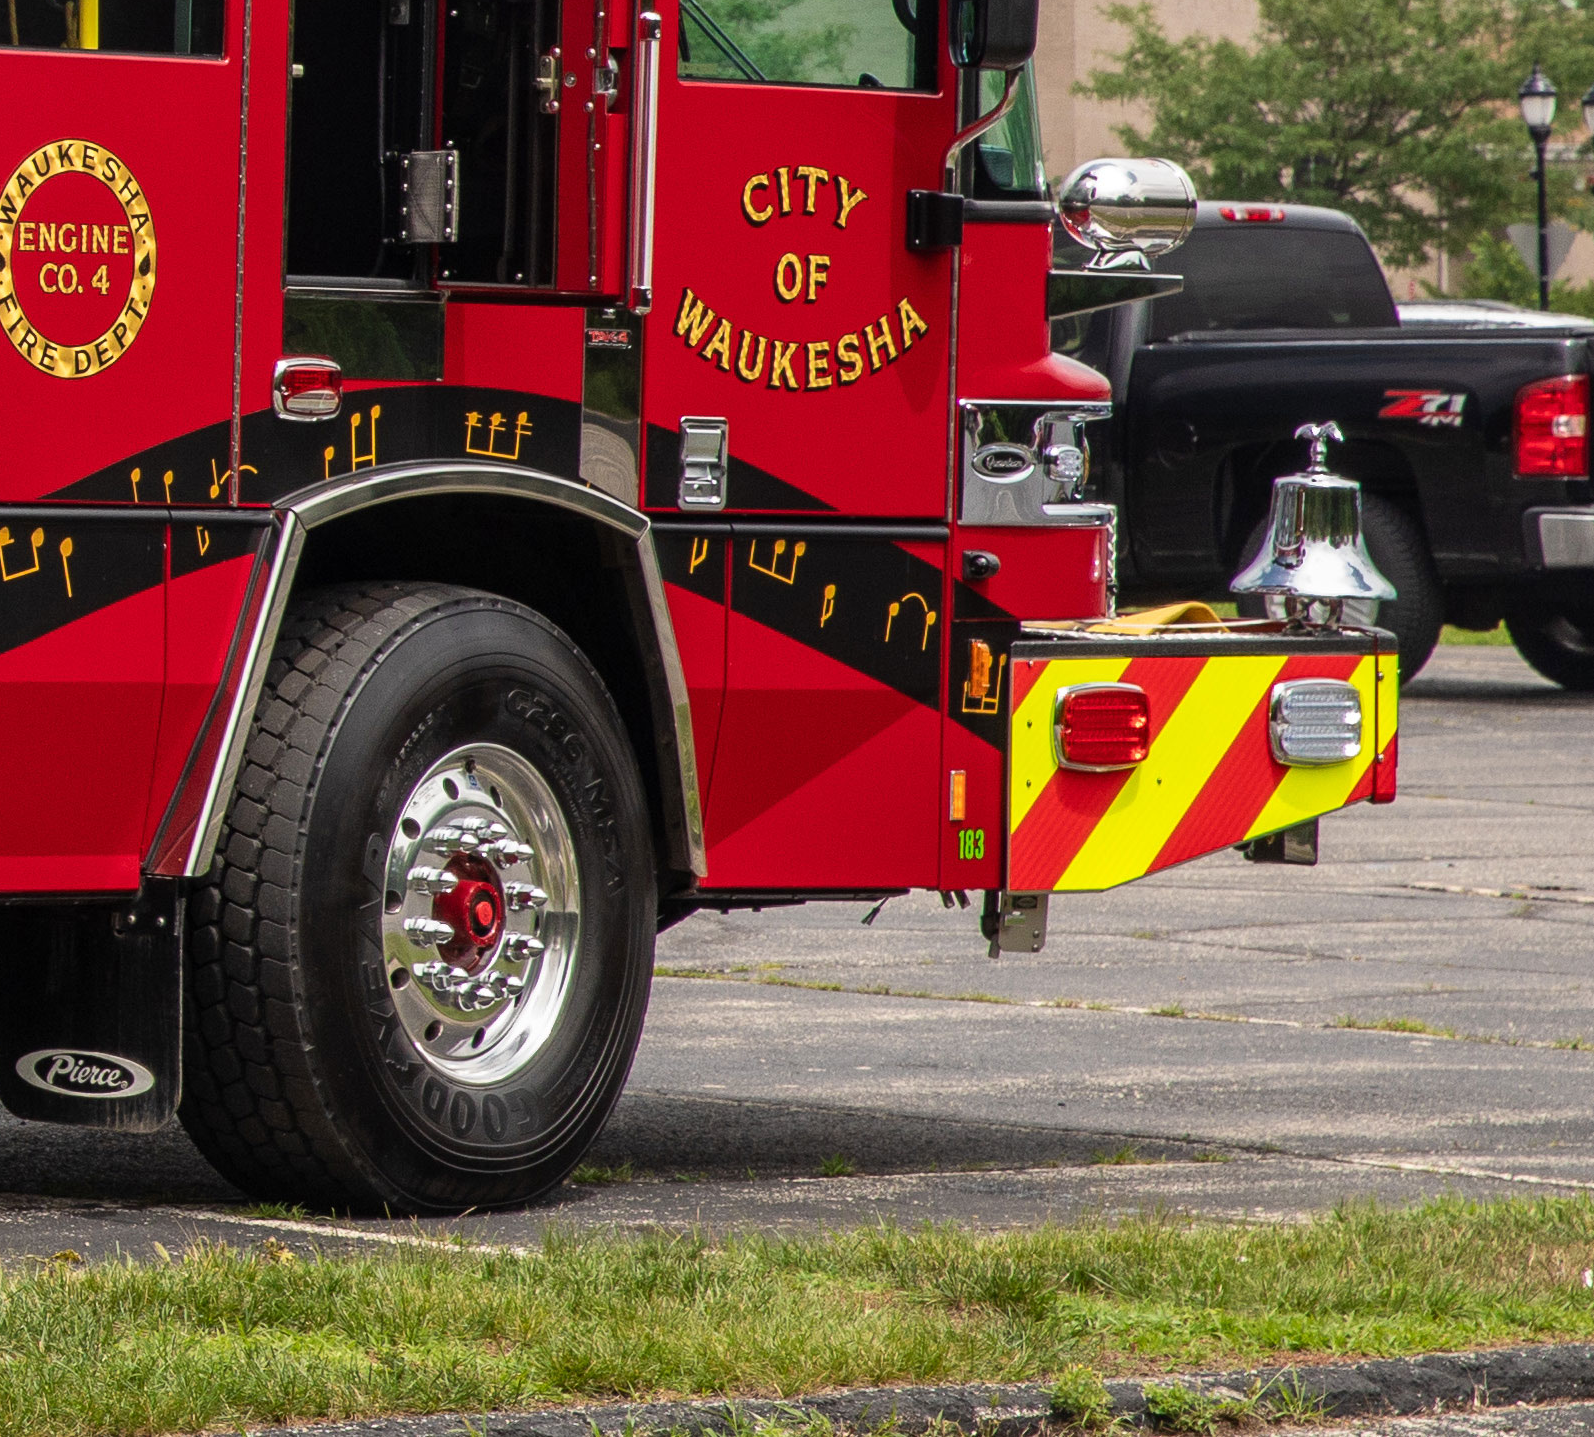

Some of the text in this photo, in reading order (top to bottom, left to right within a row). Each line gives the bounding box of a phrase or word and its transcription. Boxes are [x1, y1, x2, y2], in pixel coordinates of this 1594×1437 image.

[741, 165, 869, 229] CITY
[18, 222, 129, 254] ENGINE
[39, 262, 110, 295] CO. 4
[774, 252, 831, 304] OF
[74, 298, 148, 374] DEPT.
[673, 287, 929, 391] WAUKESHA
[1378, 389, 1468, 419] Z71
[959, 826, 985, 858] 183
[50, 1053, 123, 1088] Pierce
